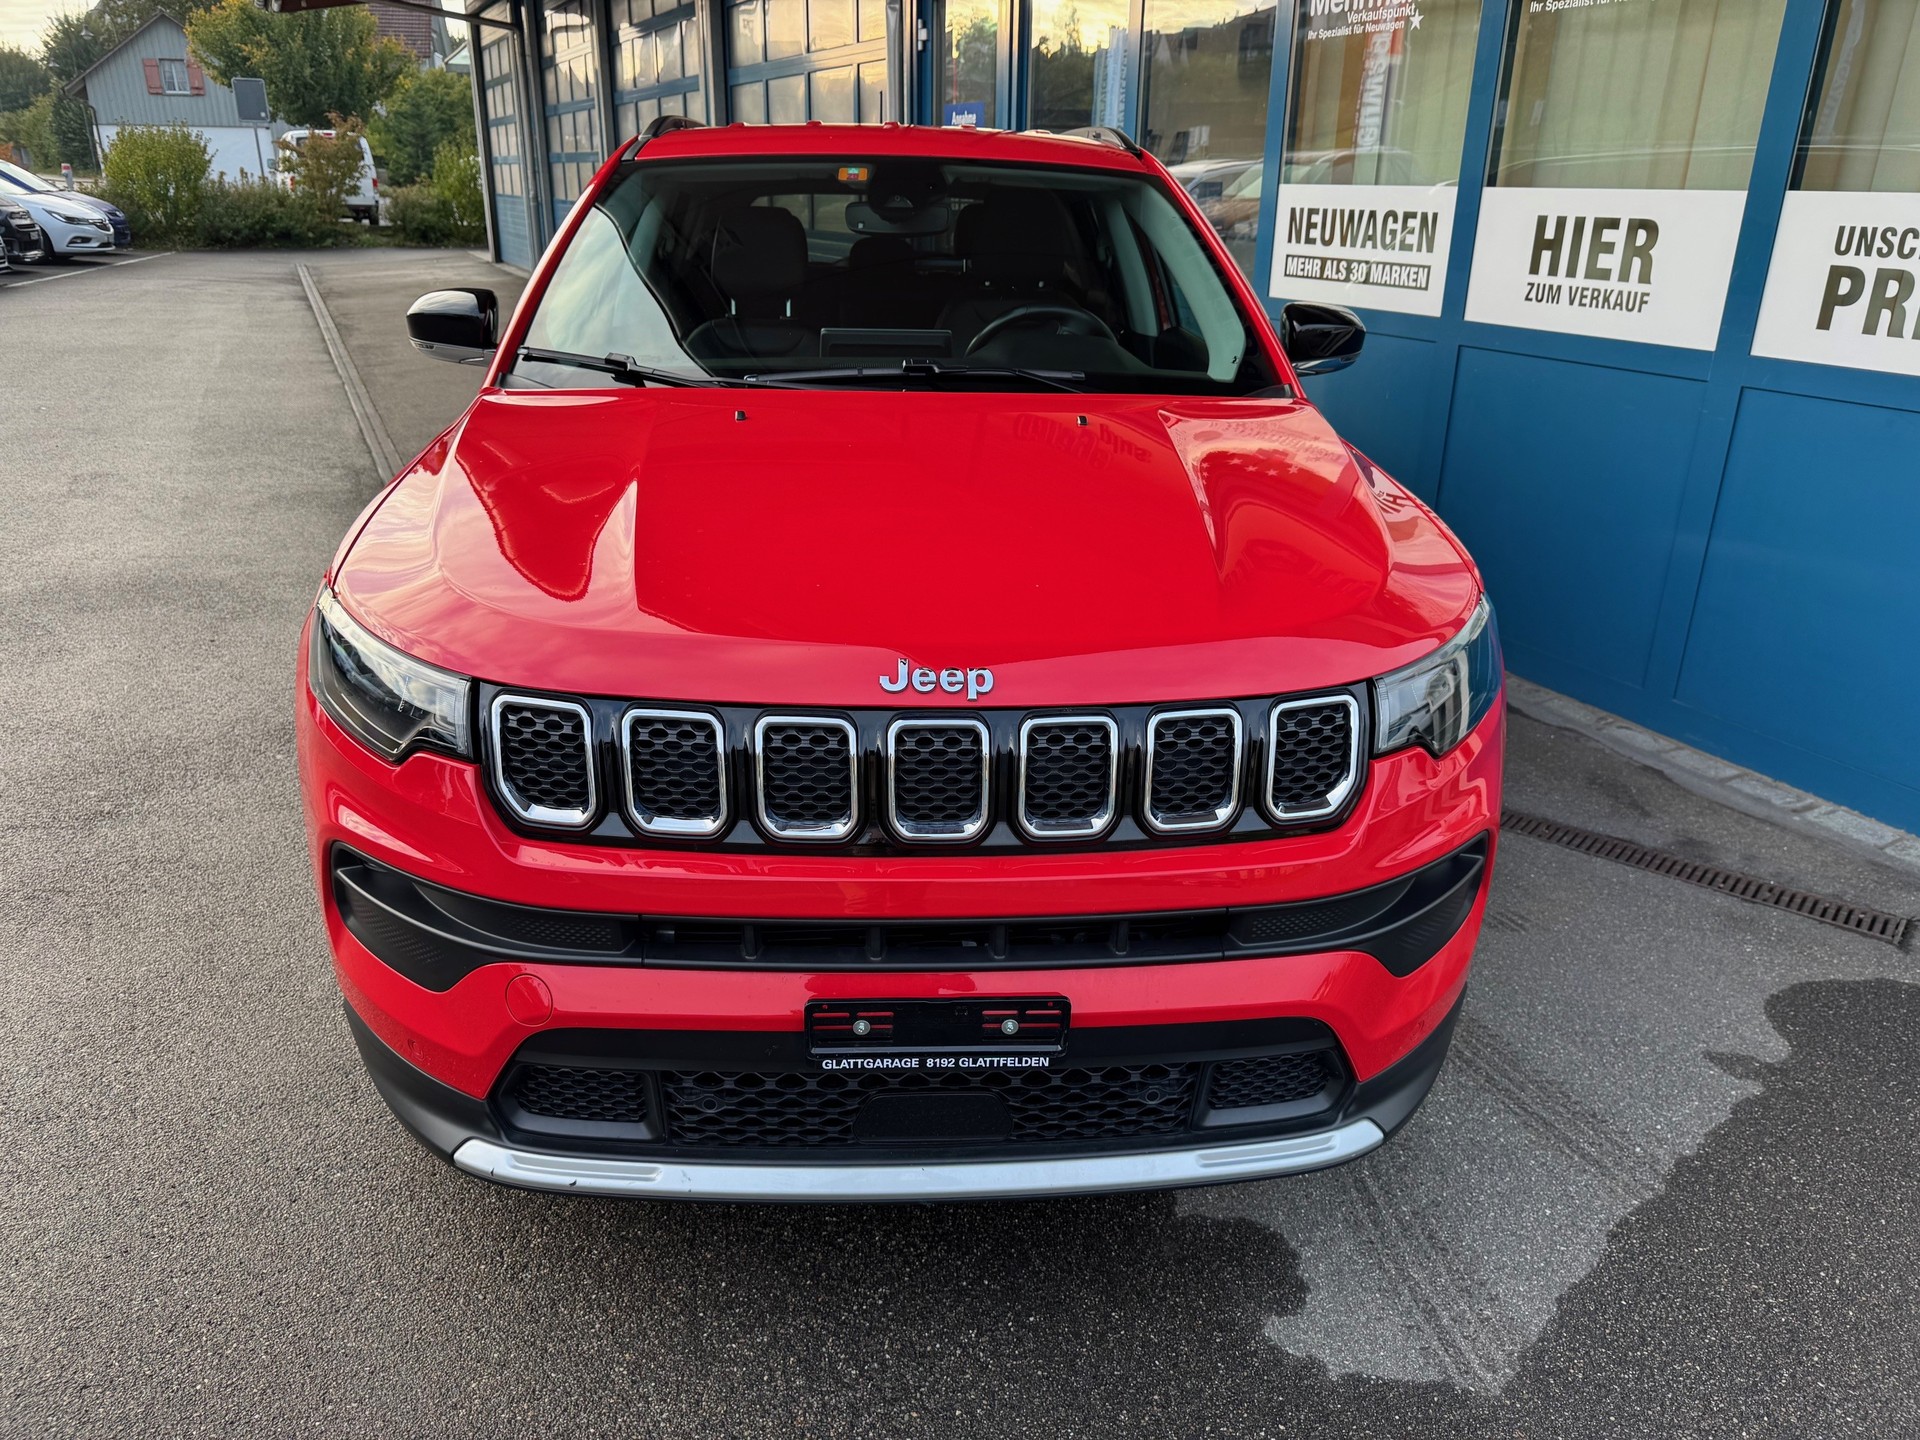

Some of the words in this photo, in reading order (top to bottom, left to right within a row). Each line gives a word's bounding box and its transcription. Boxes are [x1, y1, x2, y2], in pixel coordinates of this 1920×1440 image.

[1347, 3, 1416, 24] Verkaufspunkt
[1530, 2, 1543, 13] Ihr
[1307, 30, 1318, 40] Ihr
[1319, 25, 1352, 40] Spezialist
[1353, 23, 1364, 35] für
[1365, 20, 1405, 33] Neuwagen
[1287, 207, 1438, 253] NEUWAGEN
[1834, 225, 1920, 260] UNSC
[1528, 215, 1659, 285] HIER
[1286, 256, 1321, 278] MEHR
[1323, 259, 1347, 280] ALS
[1350, 262, 1367, 282] 30
[1369, 264, 1428, 288] MARKEN
[1524, 282, 1562, 305] ZUM
[1568, 285, 1651, 313] VERKAUF
[1815, 264, 1920, 341] PR
[879, 658, 994, 701] Jeep
[822, 1058, 920, 1070] GLATTGARAGE
[926, 1057, 955, 1068] 8192
[958, 1056, 1050, 1068] GLATTFELDEN
